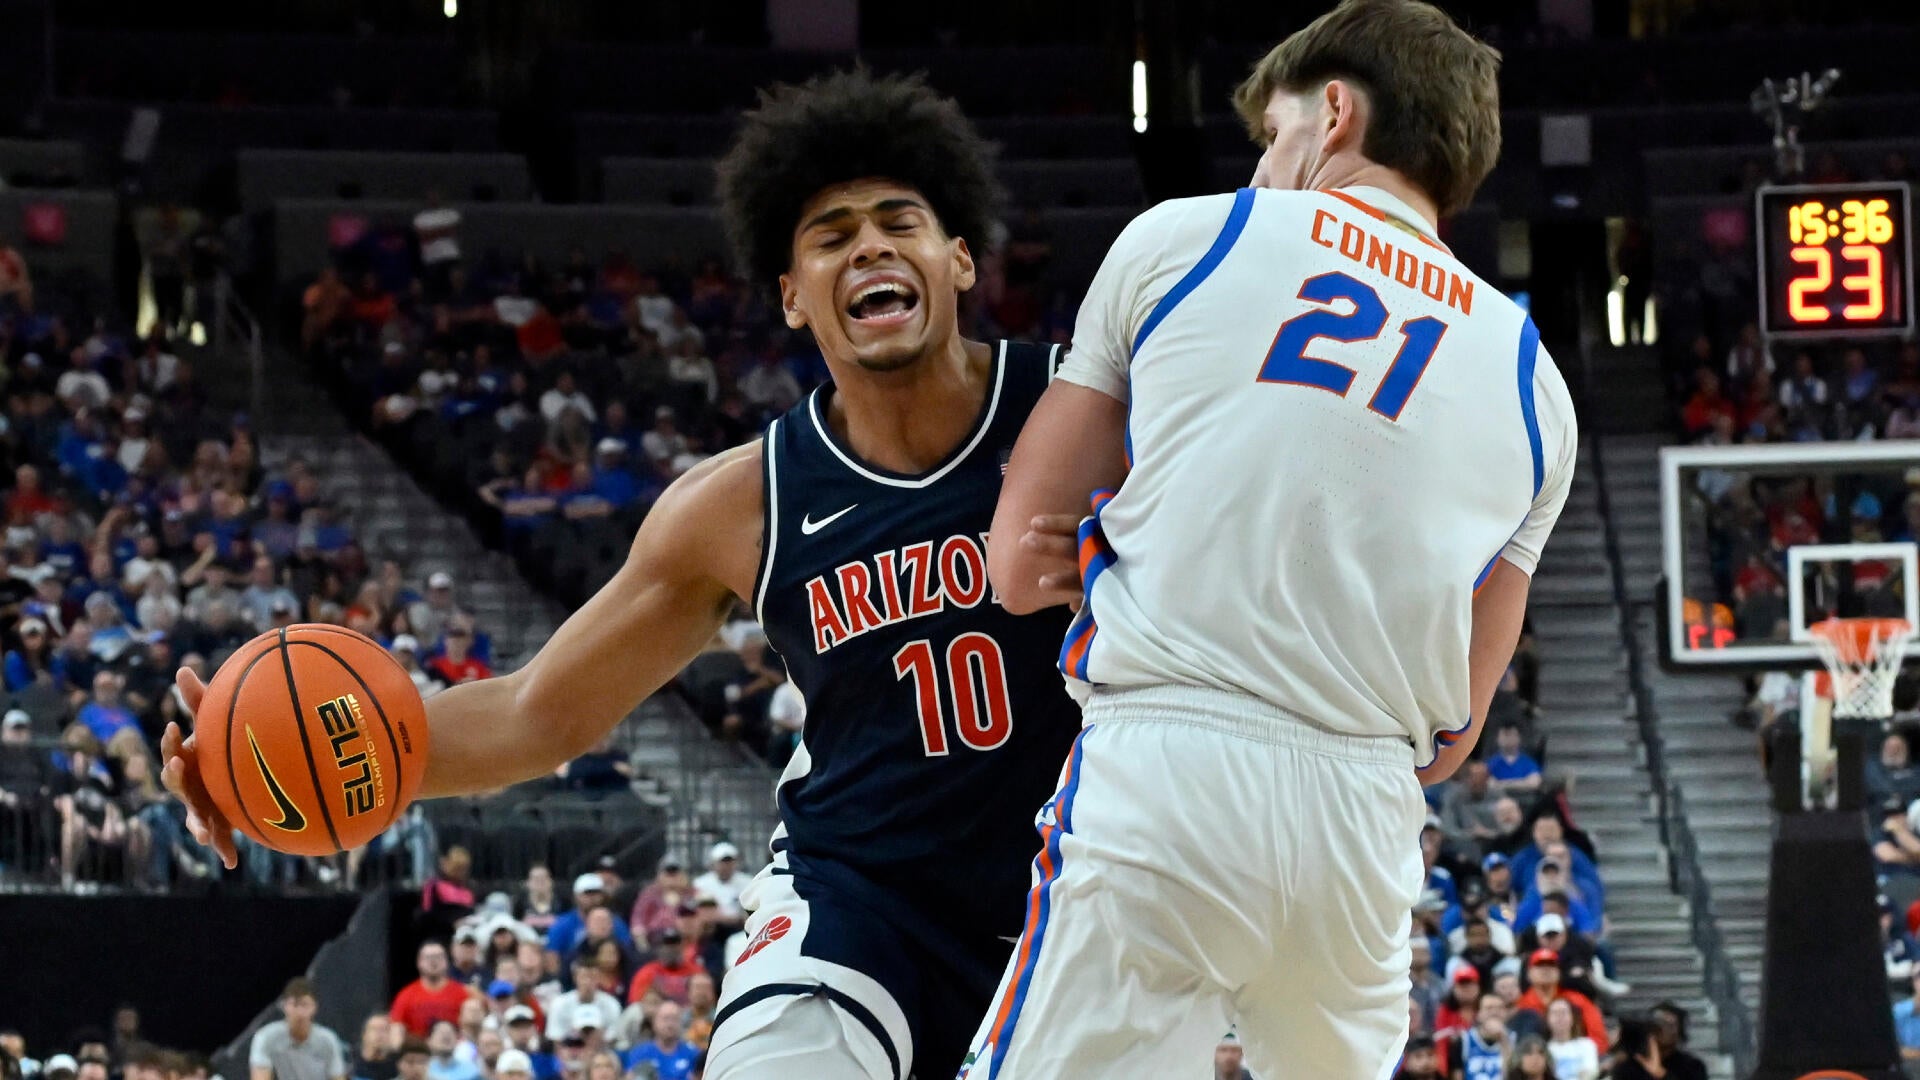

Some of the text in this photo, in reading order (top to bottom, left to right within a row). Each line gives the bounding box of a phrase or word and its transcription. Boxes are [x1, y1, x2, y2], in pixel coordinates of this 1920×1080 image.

[1311, 209, 1474, 316] CONDON
[1788, 245, 1884, 322] 23
[1789, 199, 1893, 246] 15:36
[1255, 270, 1449, 422] 21
[805, 532, 1001, 655] ARIZO
[892, 631, 1013, 757] 10
[315, 695, 376, 818] ELITE
